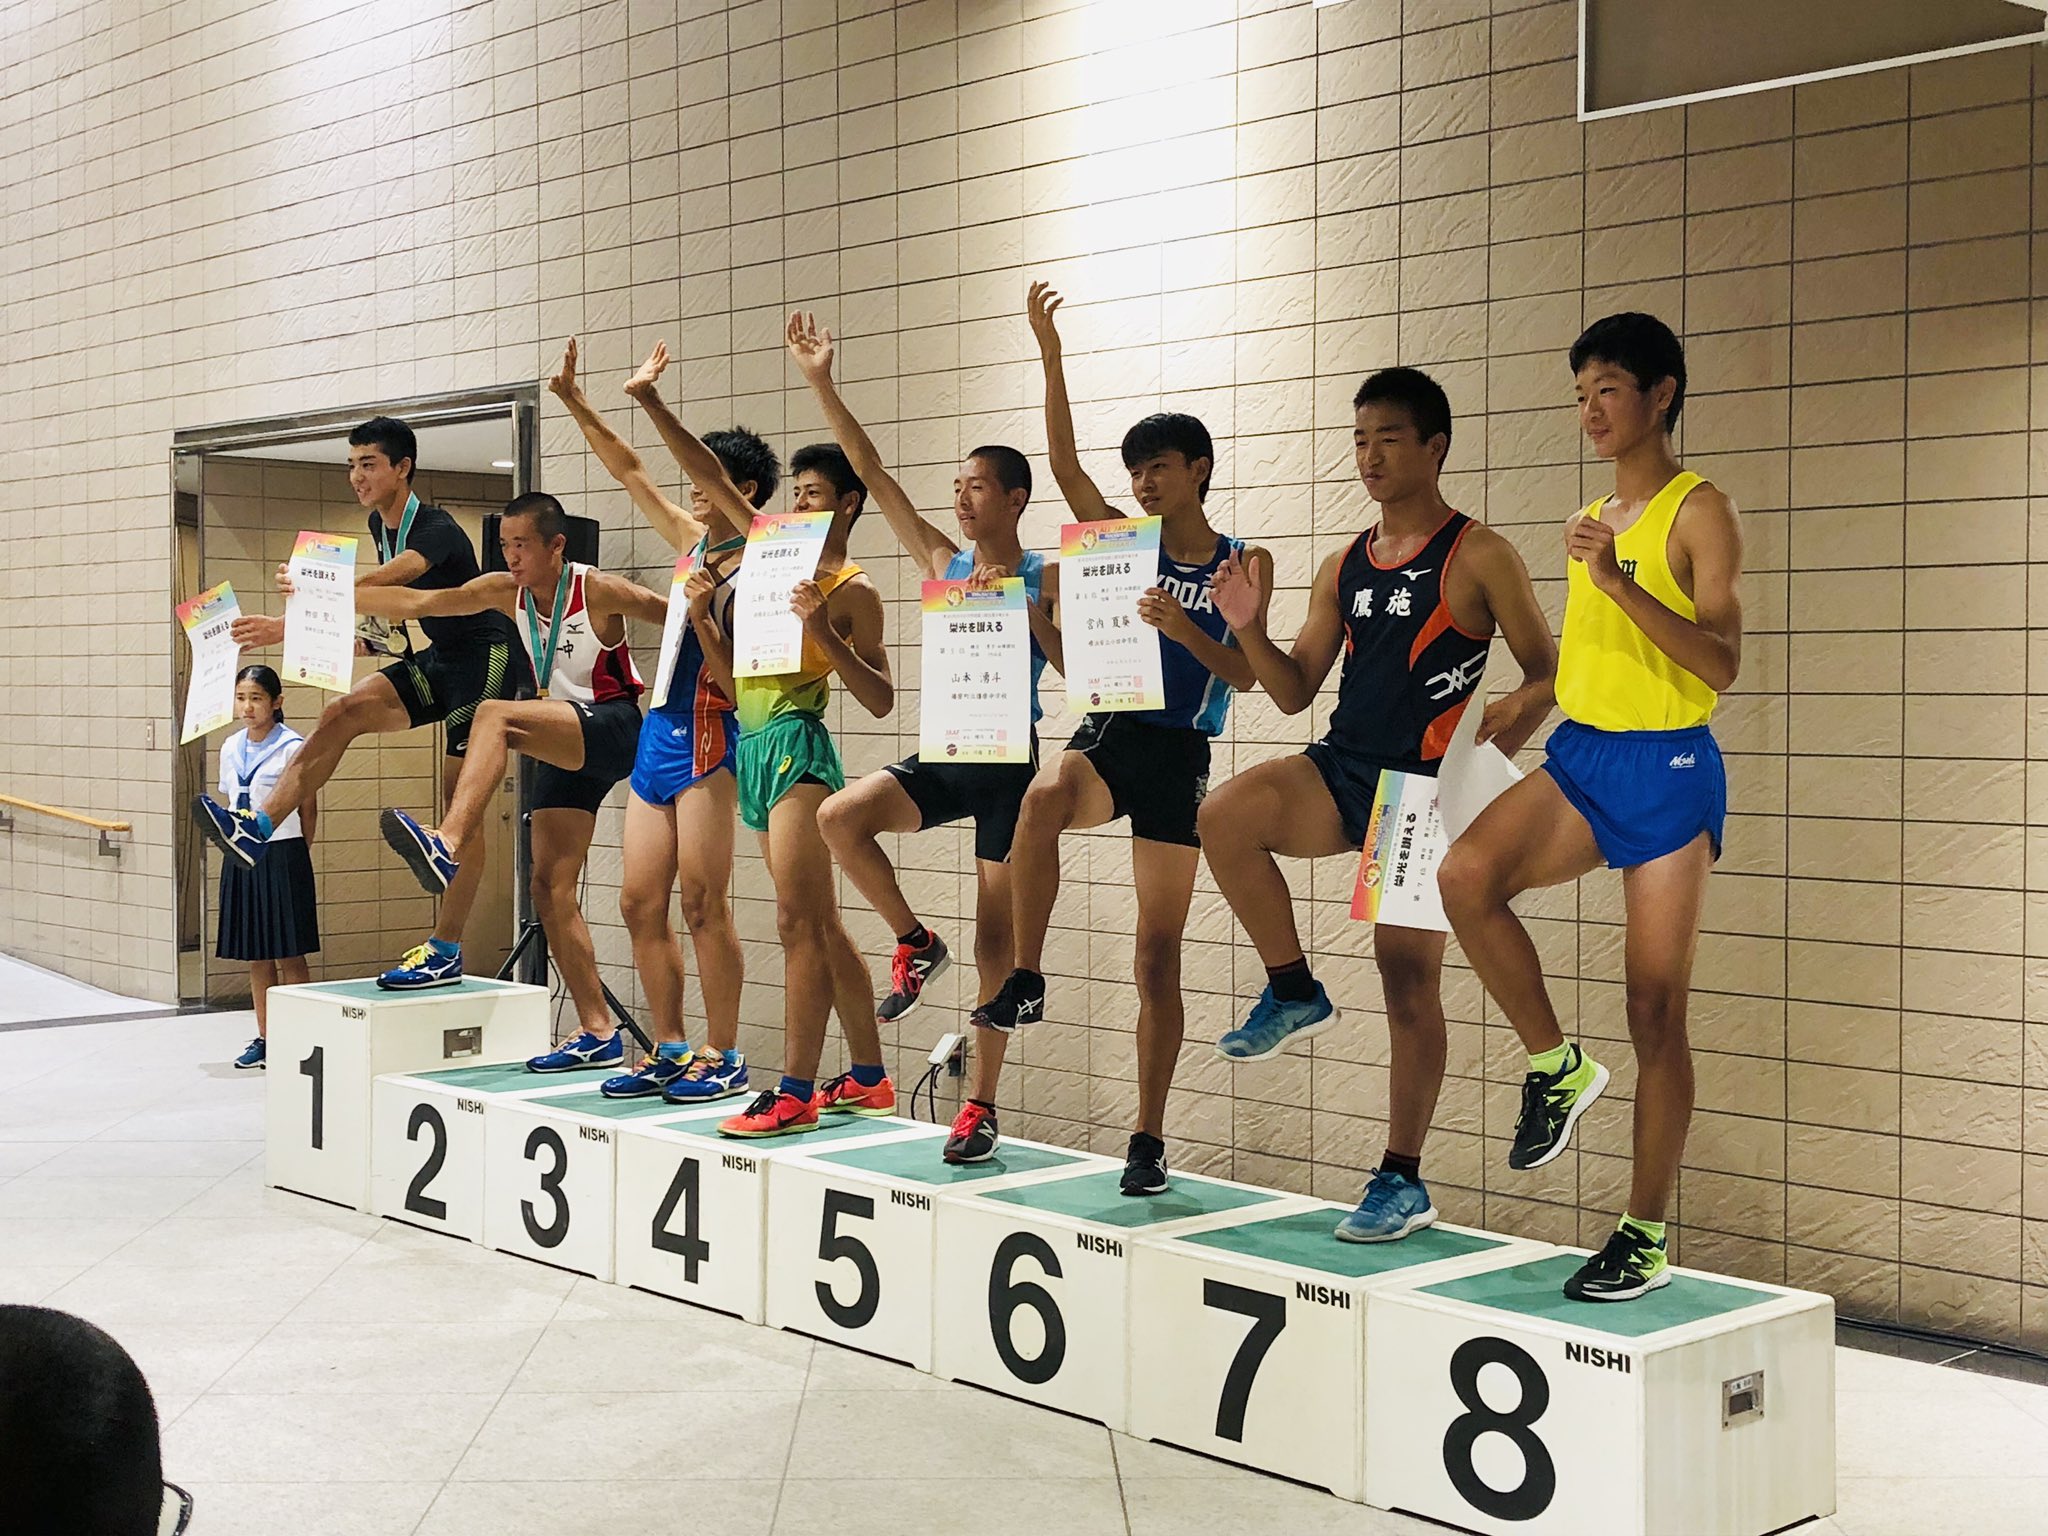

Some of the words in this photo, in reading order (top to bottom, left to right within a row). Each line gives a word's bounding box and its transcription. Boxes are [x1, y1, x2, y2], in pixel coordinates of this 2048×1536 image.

[1082, 562, 1131, 578] 栄光を讃える
[949, 621, 1003, 633] 栄光を讃える
[1393, 812, 1417, 887] 栄光を讃える
[300, 1046, 323, 1150] 1
[405, 1103, 447, 1220] 2
[521, 1126, 570, 1248] 3
[722, 1155, 756, 1174] NISHI
[891, 1189, 930, 1211] NISHI
[652, 1157, 709, 1284] 4
[815, 1189, 880, 1329] 5
[1077, 1232, 1123, 1258] NISHI
[989, 1231, 1067, 1384] 6
[1296, 1281, 1350, 1310] NISHI
[1203, 1278, 1286, 1443] 7
[1565, 1341, 1631, 1374] NISHI
[1443, 1336, 1556, 1521] 8
